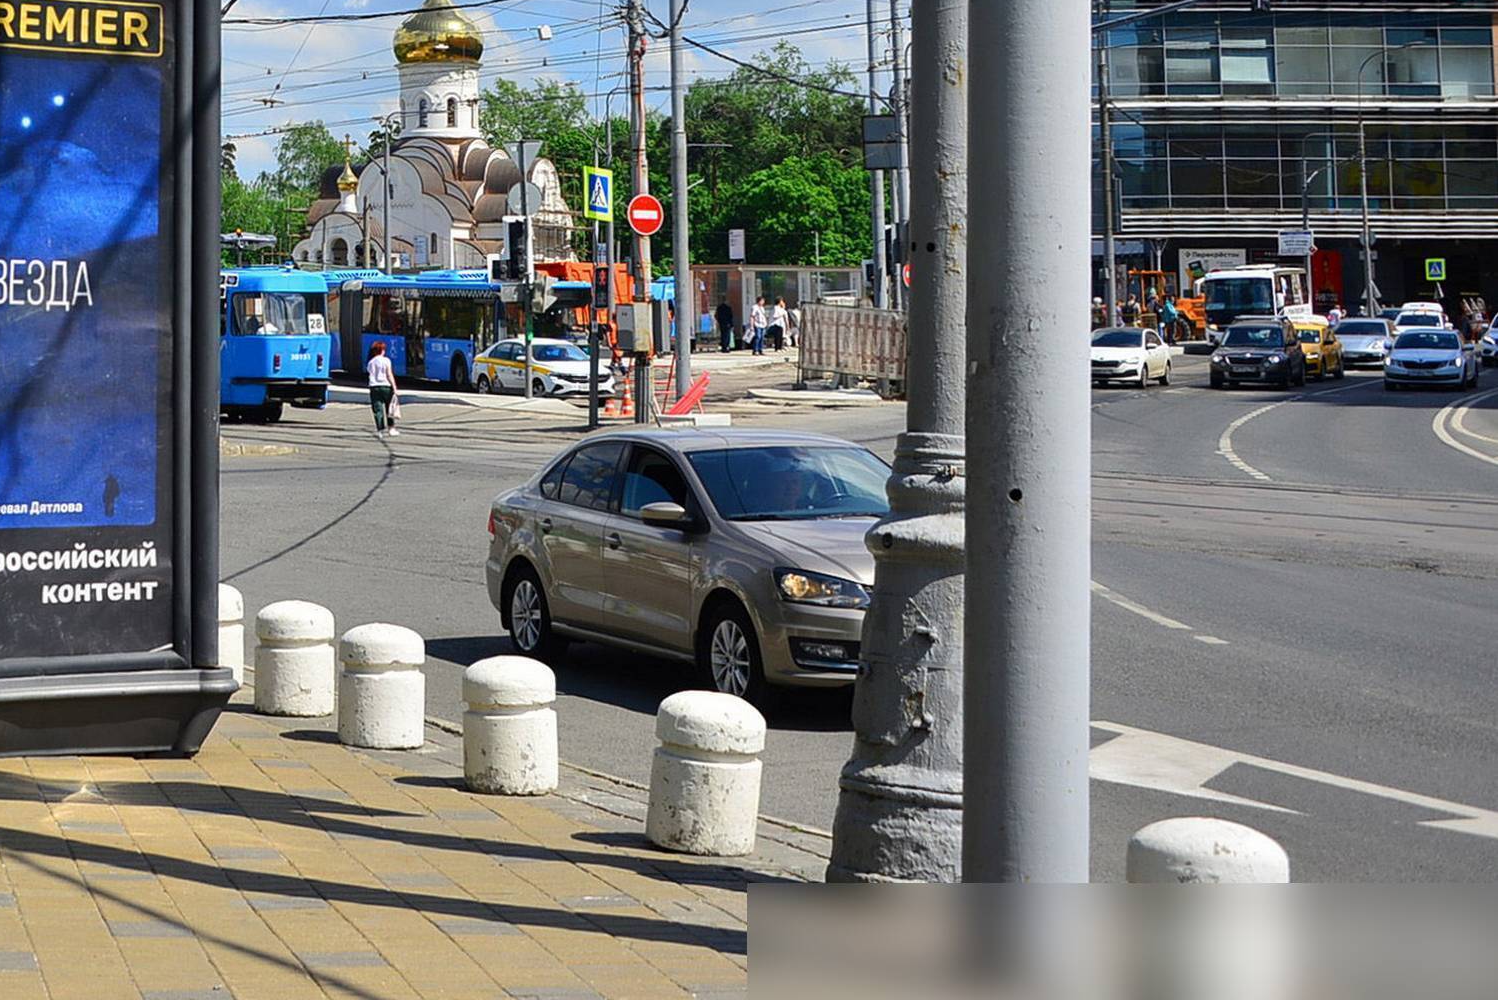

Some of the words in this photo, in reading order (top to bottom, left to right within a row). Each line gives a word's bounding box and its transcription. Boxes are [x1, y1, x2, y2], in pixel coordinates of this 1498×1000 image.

[310, 318, 323, 329] 28
[29, 501, 83, 515] Дятлова
[41, 581, 159, 605] контент
